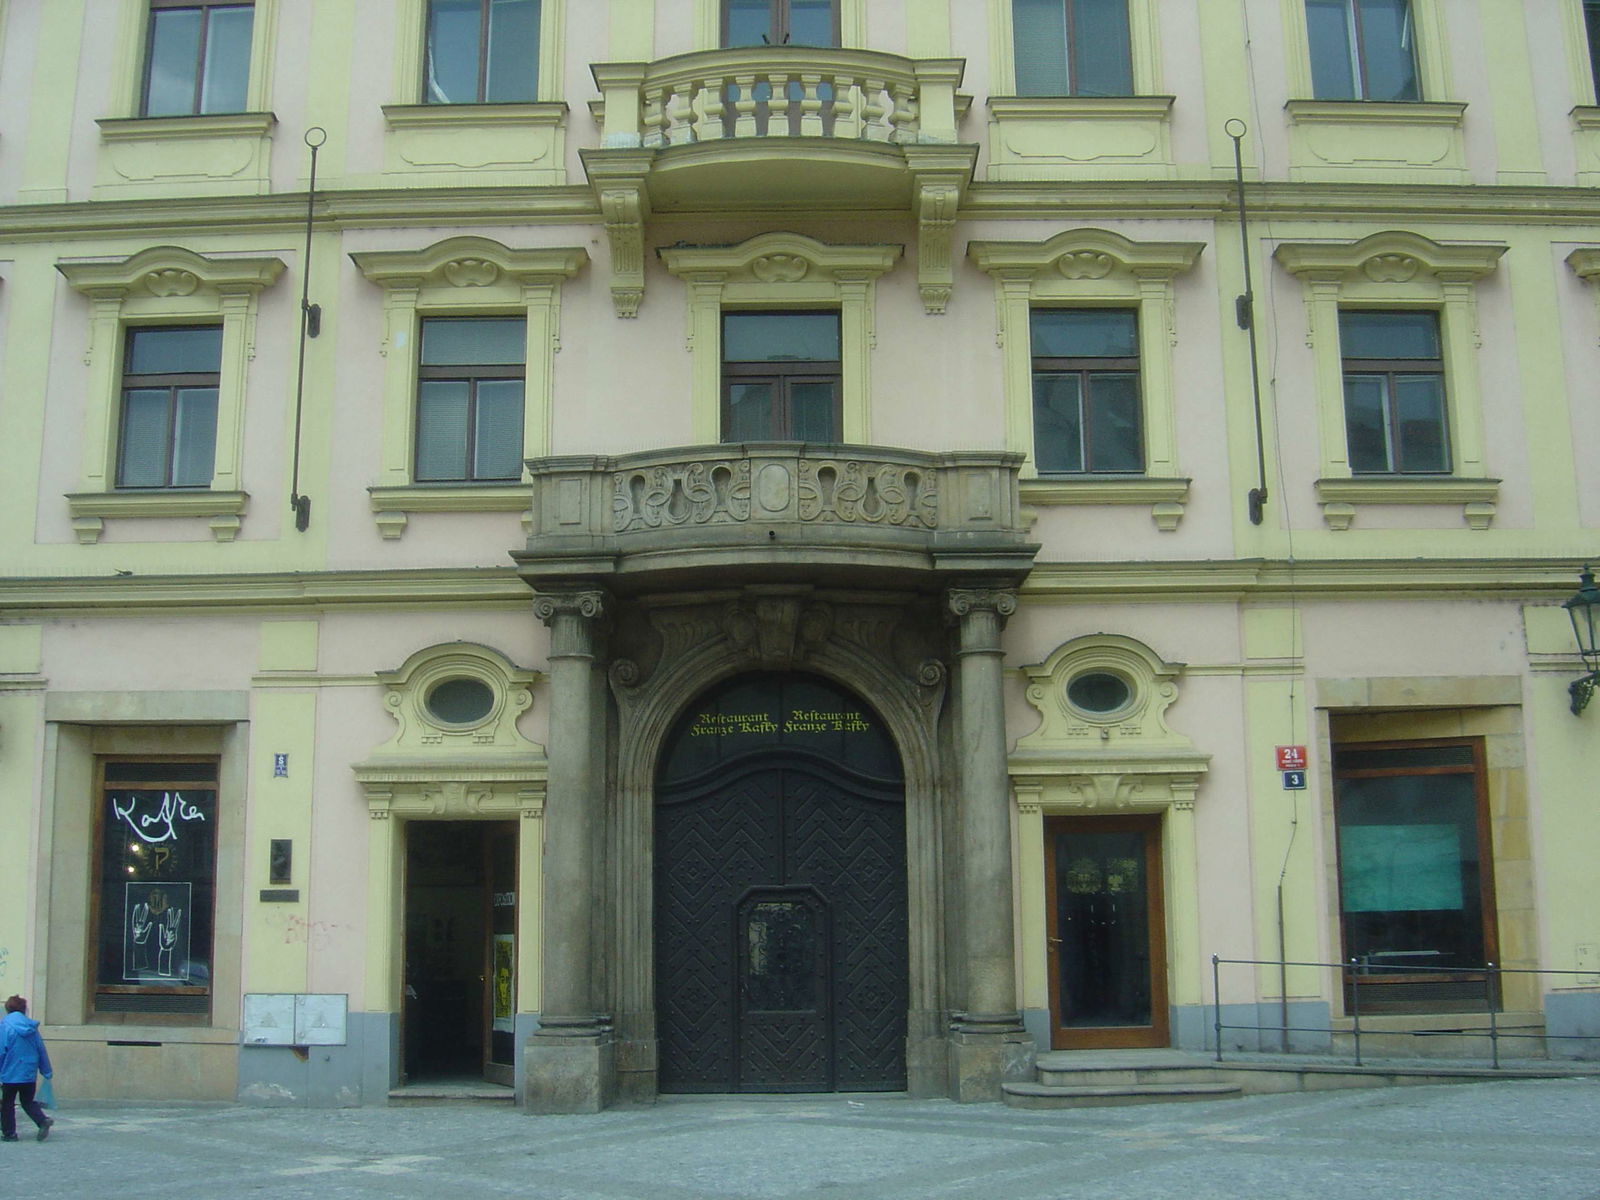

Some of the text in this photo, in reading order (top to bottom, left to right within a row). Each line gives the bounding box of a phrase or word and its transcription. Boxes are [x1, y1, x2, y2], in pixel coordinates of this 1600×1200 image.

[700, 713, 769, 724] Restaurant
[792, 710, 861, 721] Restaurant
[1284, 748, 1297, 759] 24
[1292, 774, 1299, 784] 3
